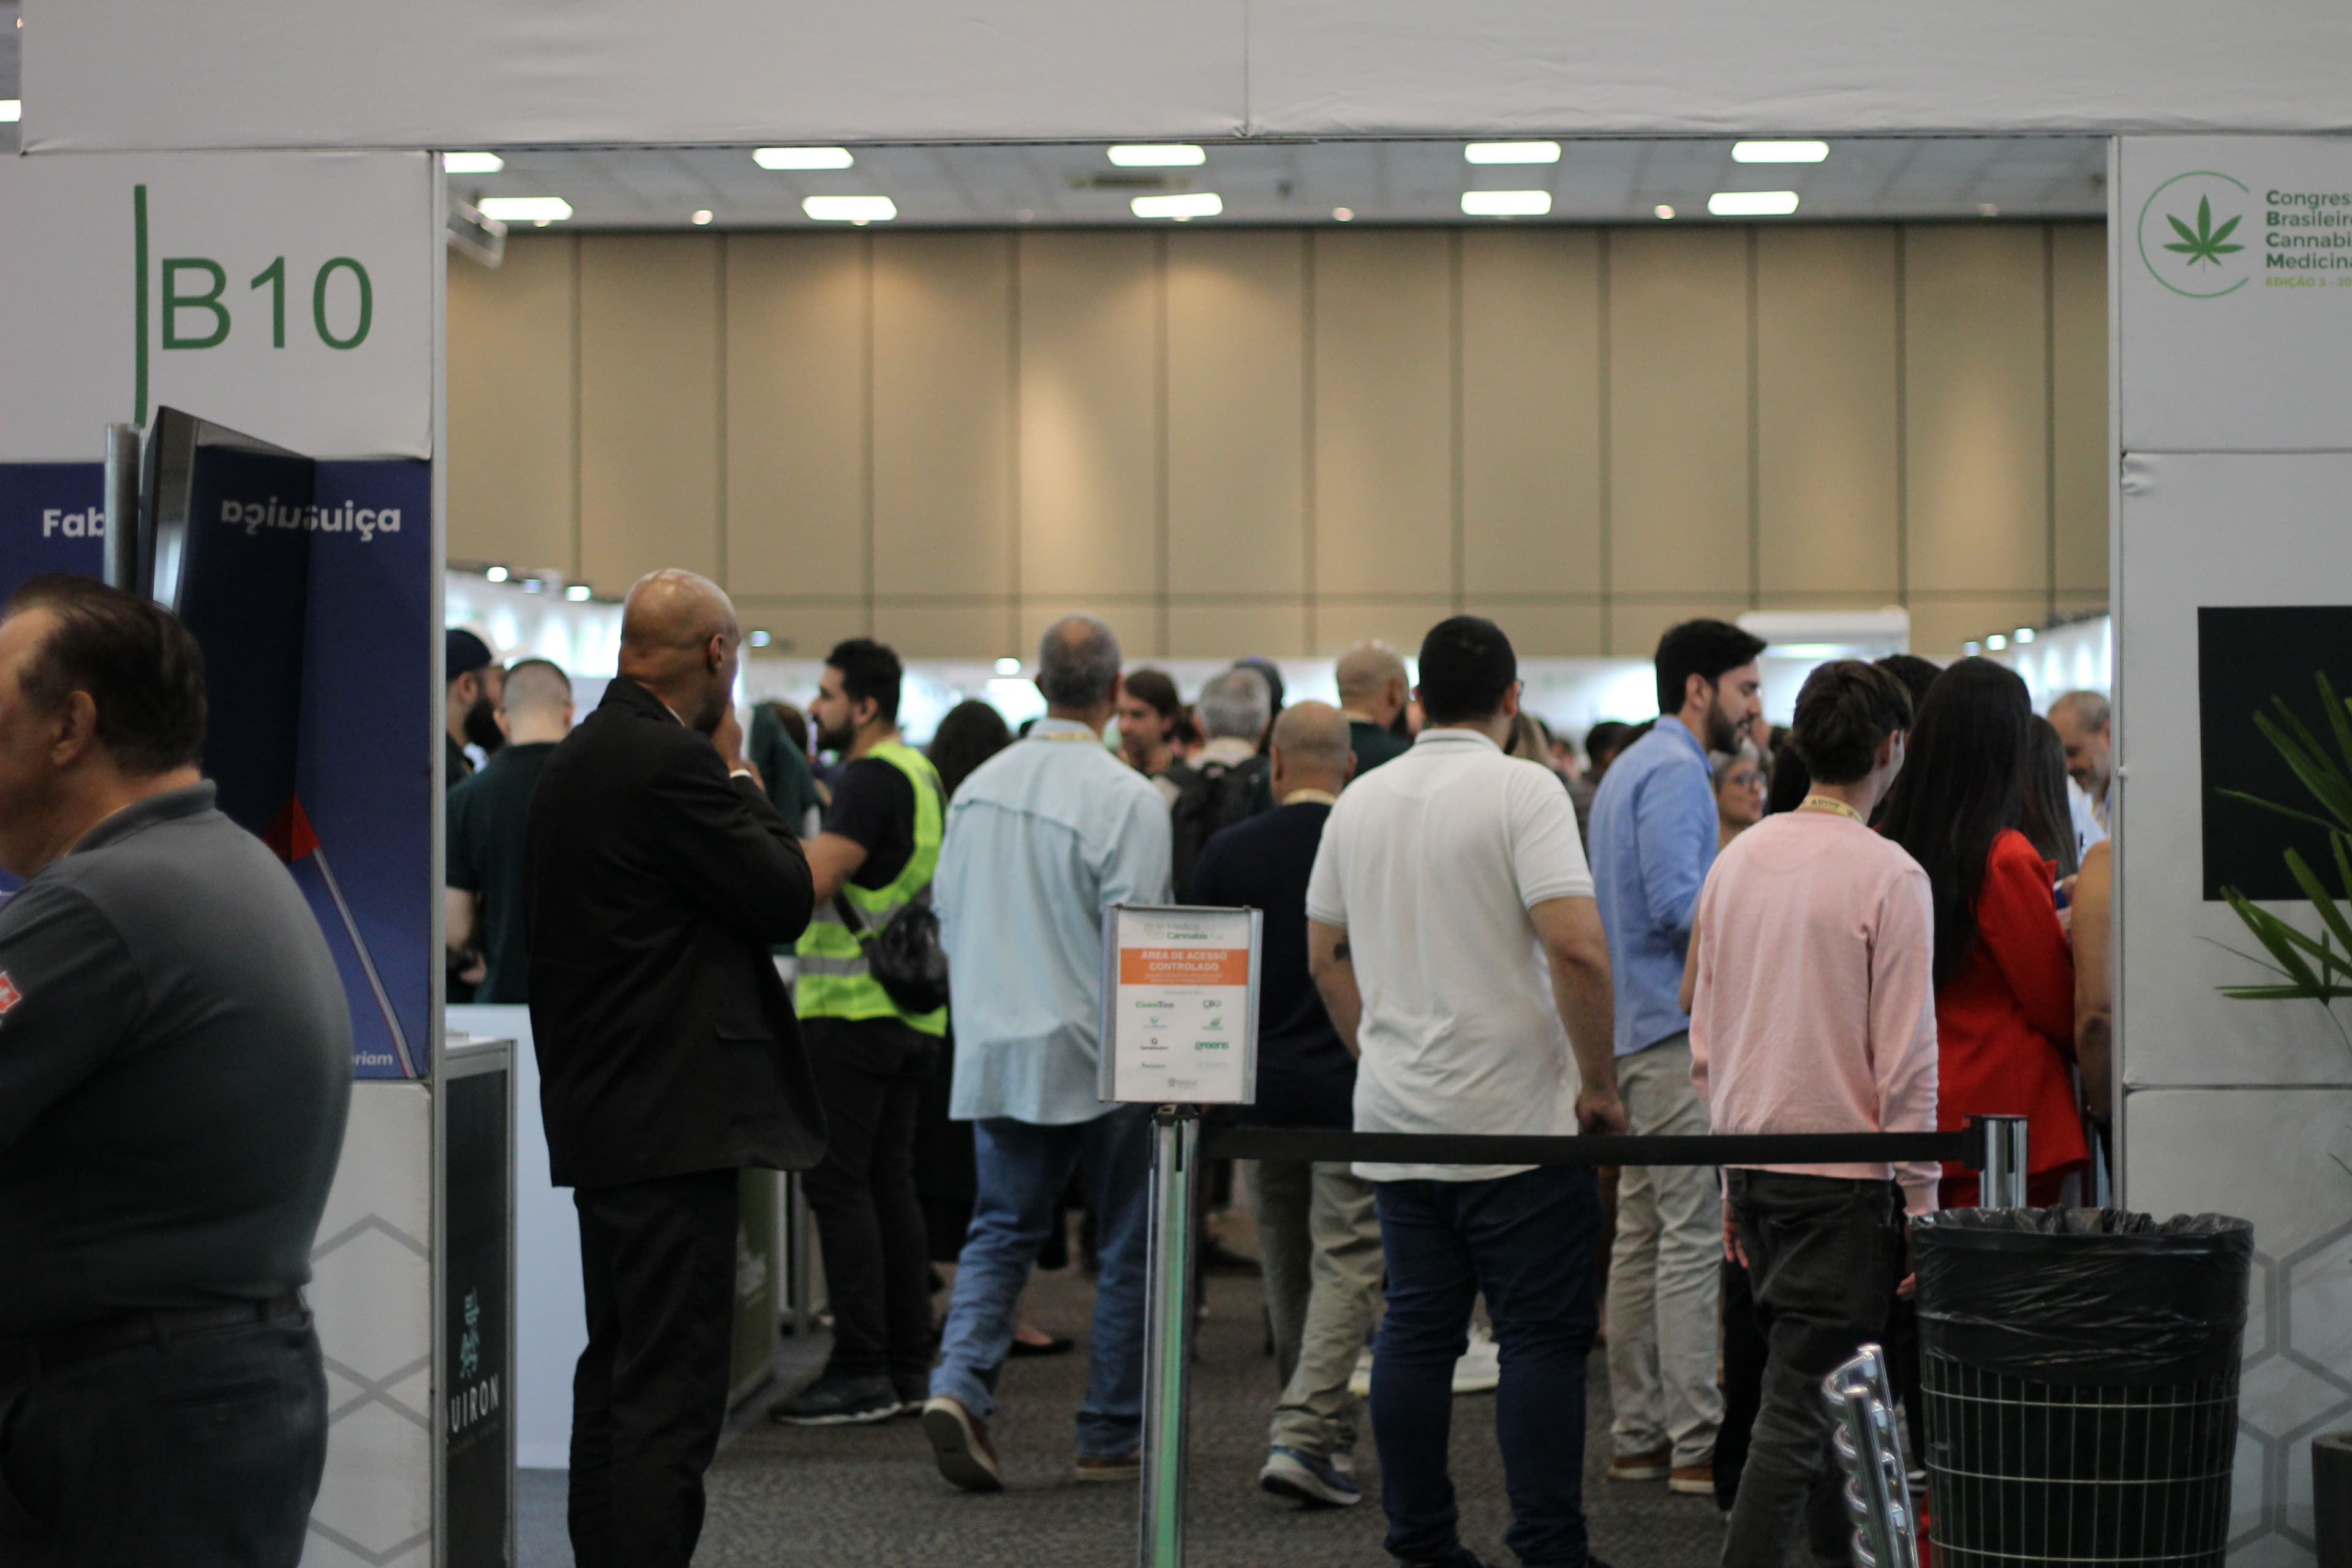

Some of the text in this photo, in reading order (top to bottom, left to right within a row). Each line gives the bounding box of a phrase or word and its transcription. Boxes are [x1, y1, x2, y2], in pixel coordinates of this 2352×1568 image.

[2266, 189, 2352, 209] Congres
[2266, 210, 2352, 227] Brasileir
[161, 255, 373, 350] B10
[1170, 951, 1184, 960] DE
[1186, 951, 1227, 960] ACESSO
[1149, 962, 1219, 971] CONTROLADO
[448, 1373, 499, 1439] UIRON
